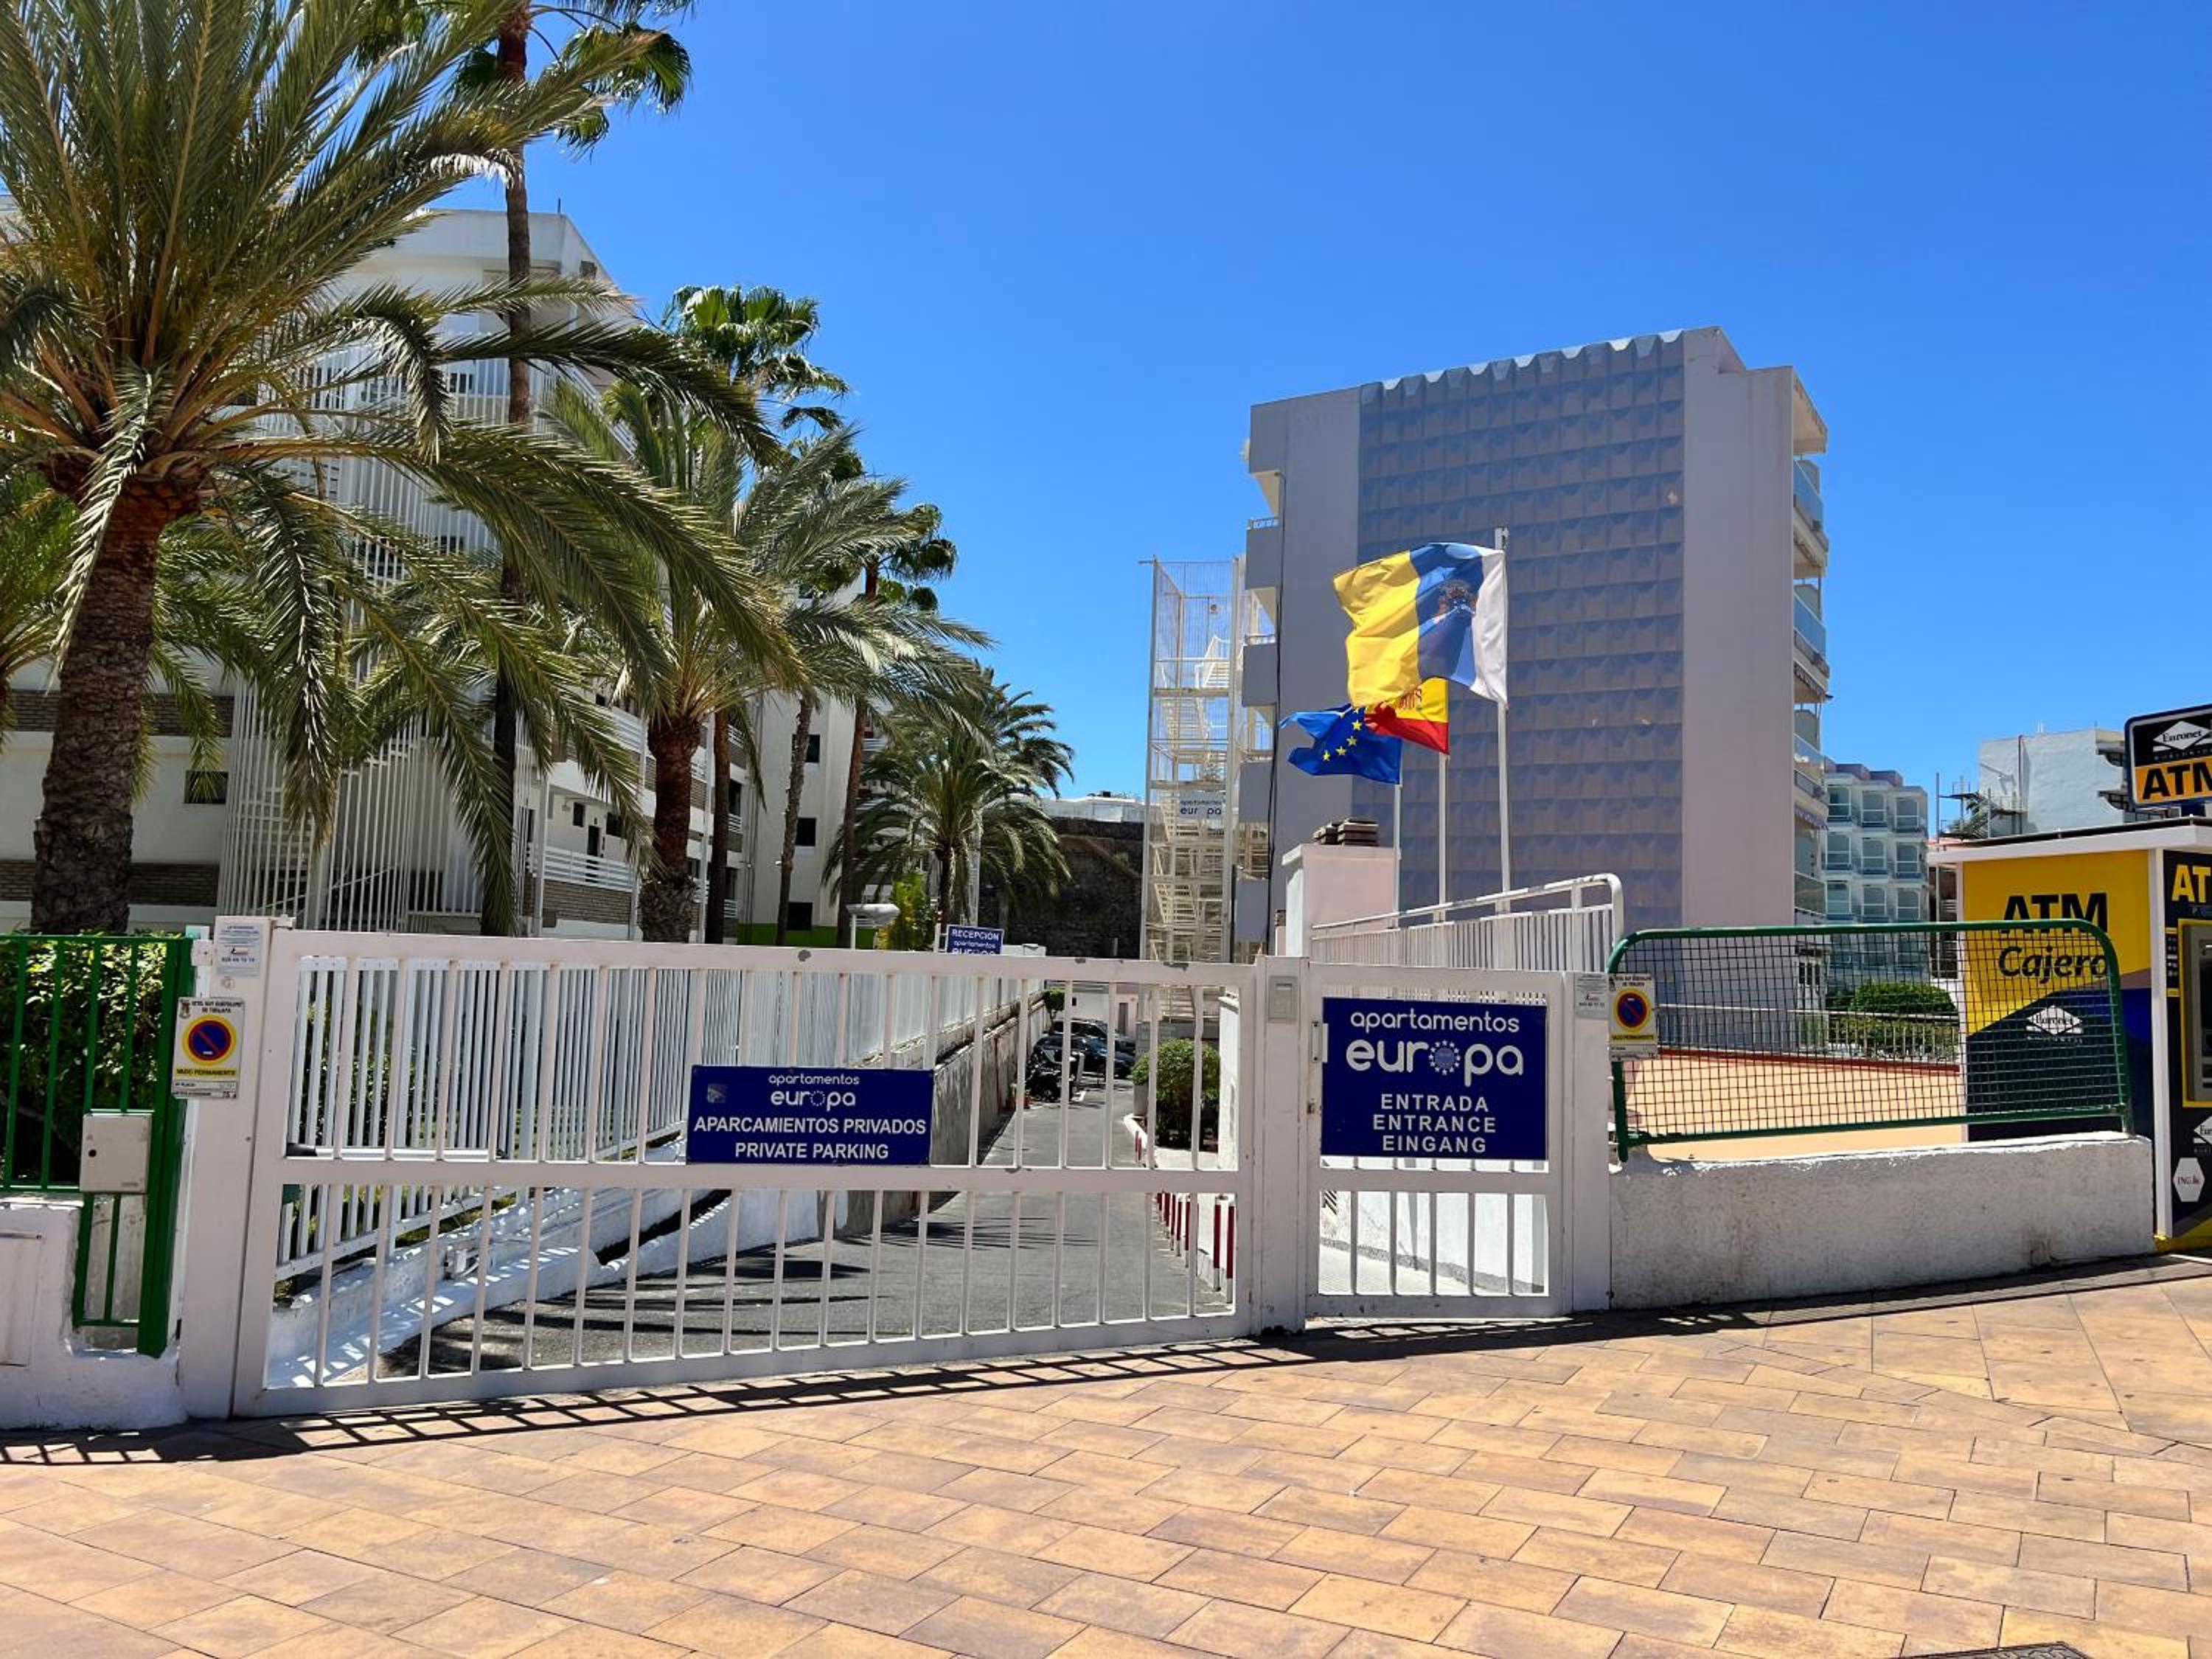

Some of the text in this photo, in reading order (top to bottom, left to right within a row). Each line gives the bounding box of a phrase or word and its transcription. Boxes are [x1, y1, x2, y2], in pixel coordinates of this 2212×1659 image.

[2162, 730, 2202, 742] Euronet
[1180, 807, 1222, 818] eurpa
[2000, 893, 2108, 933] ATM
[1999, 945, 2110, 984] Cajero
[1350, 1008, 1520, 1034] apartamentos
[1346, 1039, 1523, 1088] europa
[768, 1073, 860, 1087] apartamentos
[771, 1090, 856, 1111] europa
[1380, 1093, 1489, 1112] ENTRADA
[694, 1116, 926, 1135] APARCAMIENTOS PRIVADOS
[1372, 1114, 1497, 1133] ENTRANCE
[735, 1143, 888, 1159] PRIVATE PARKING
[1382, 1135, 1486, 1153] EINGANG
